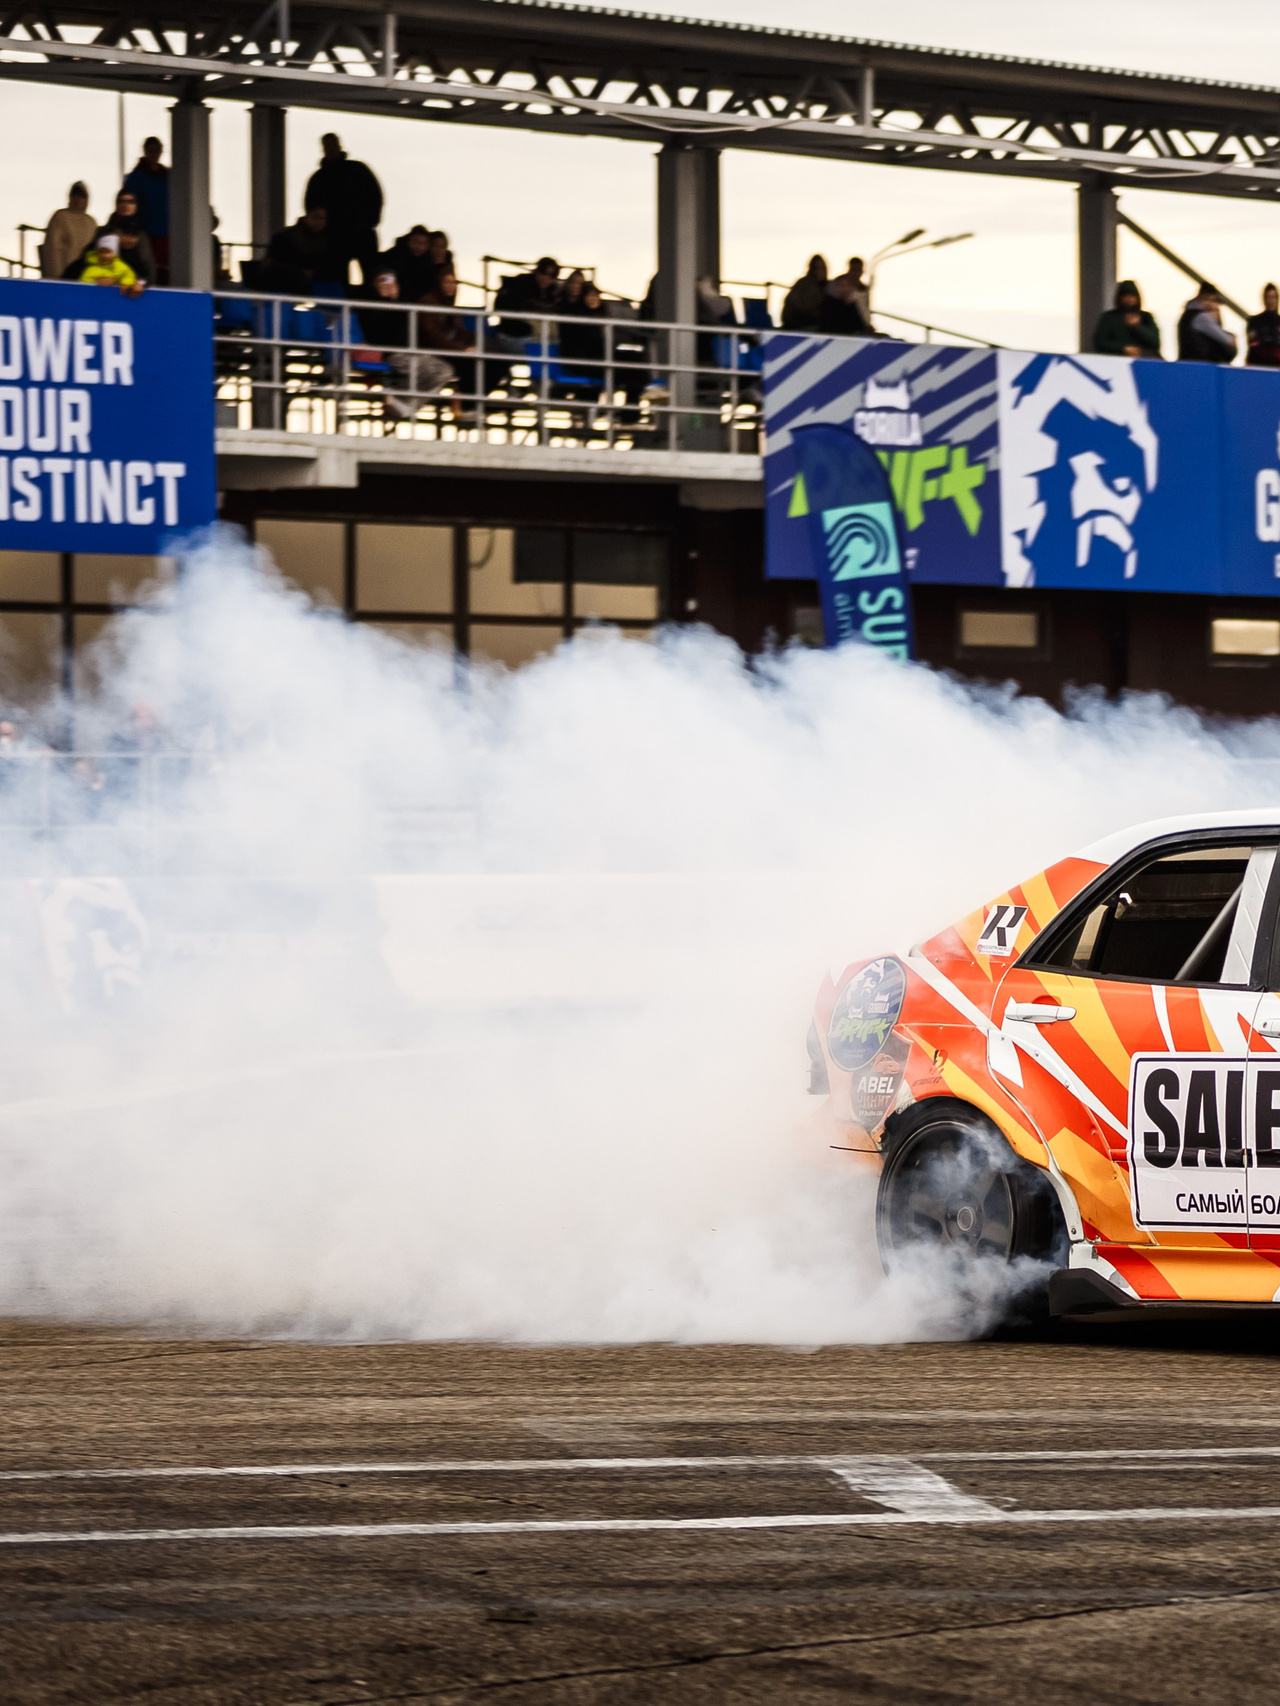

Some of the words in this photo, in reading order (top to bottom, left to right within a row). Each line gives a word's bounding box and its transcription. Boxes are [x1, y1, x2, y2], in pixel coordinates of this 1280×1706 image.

[0, 456, 187, 526] STINCT
[857, 1076, 895, 1094] ABEL
[1175, 1188, 1245, 1214] САМЫЙ
